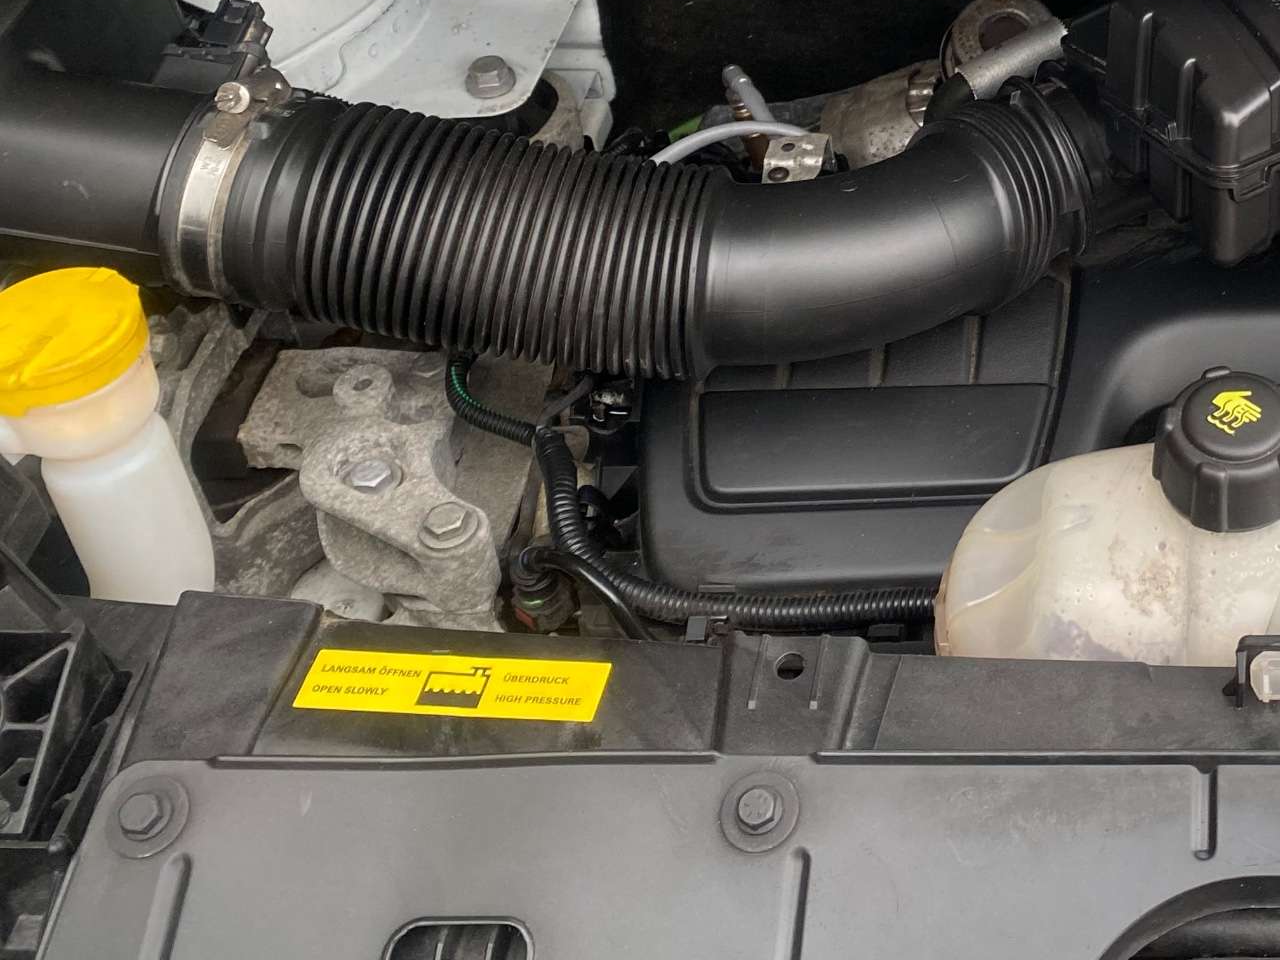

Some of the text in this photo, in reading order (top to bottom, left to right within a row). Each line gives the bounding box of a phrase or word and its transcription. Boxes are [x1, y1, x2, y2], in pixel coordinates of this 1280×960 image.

[320, 664, 422, 678] LANGSAM ÖFFNEN
[503, 672, 570, 685] ÜBERDRUCK
[312, 684, 389, 696] OPEN SLOWLY
[495, 694, 583, 706] HIGH PRESSURE
